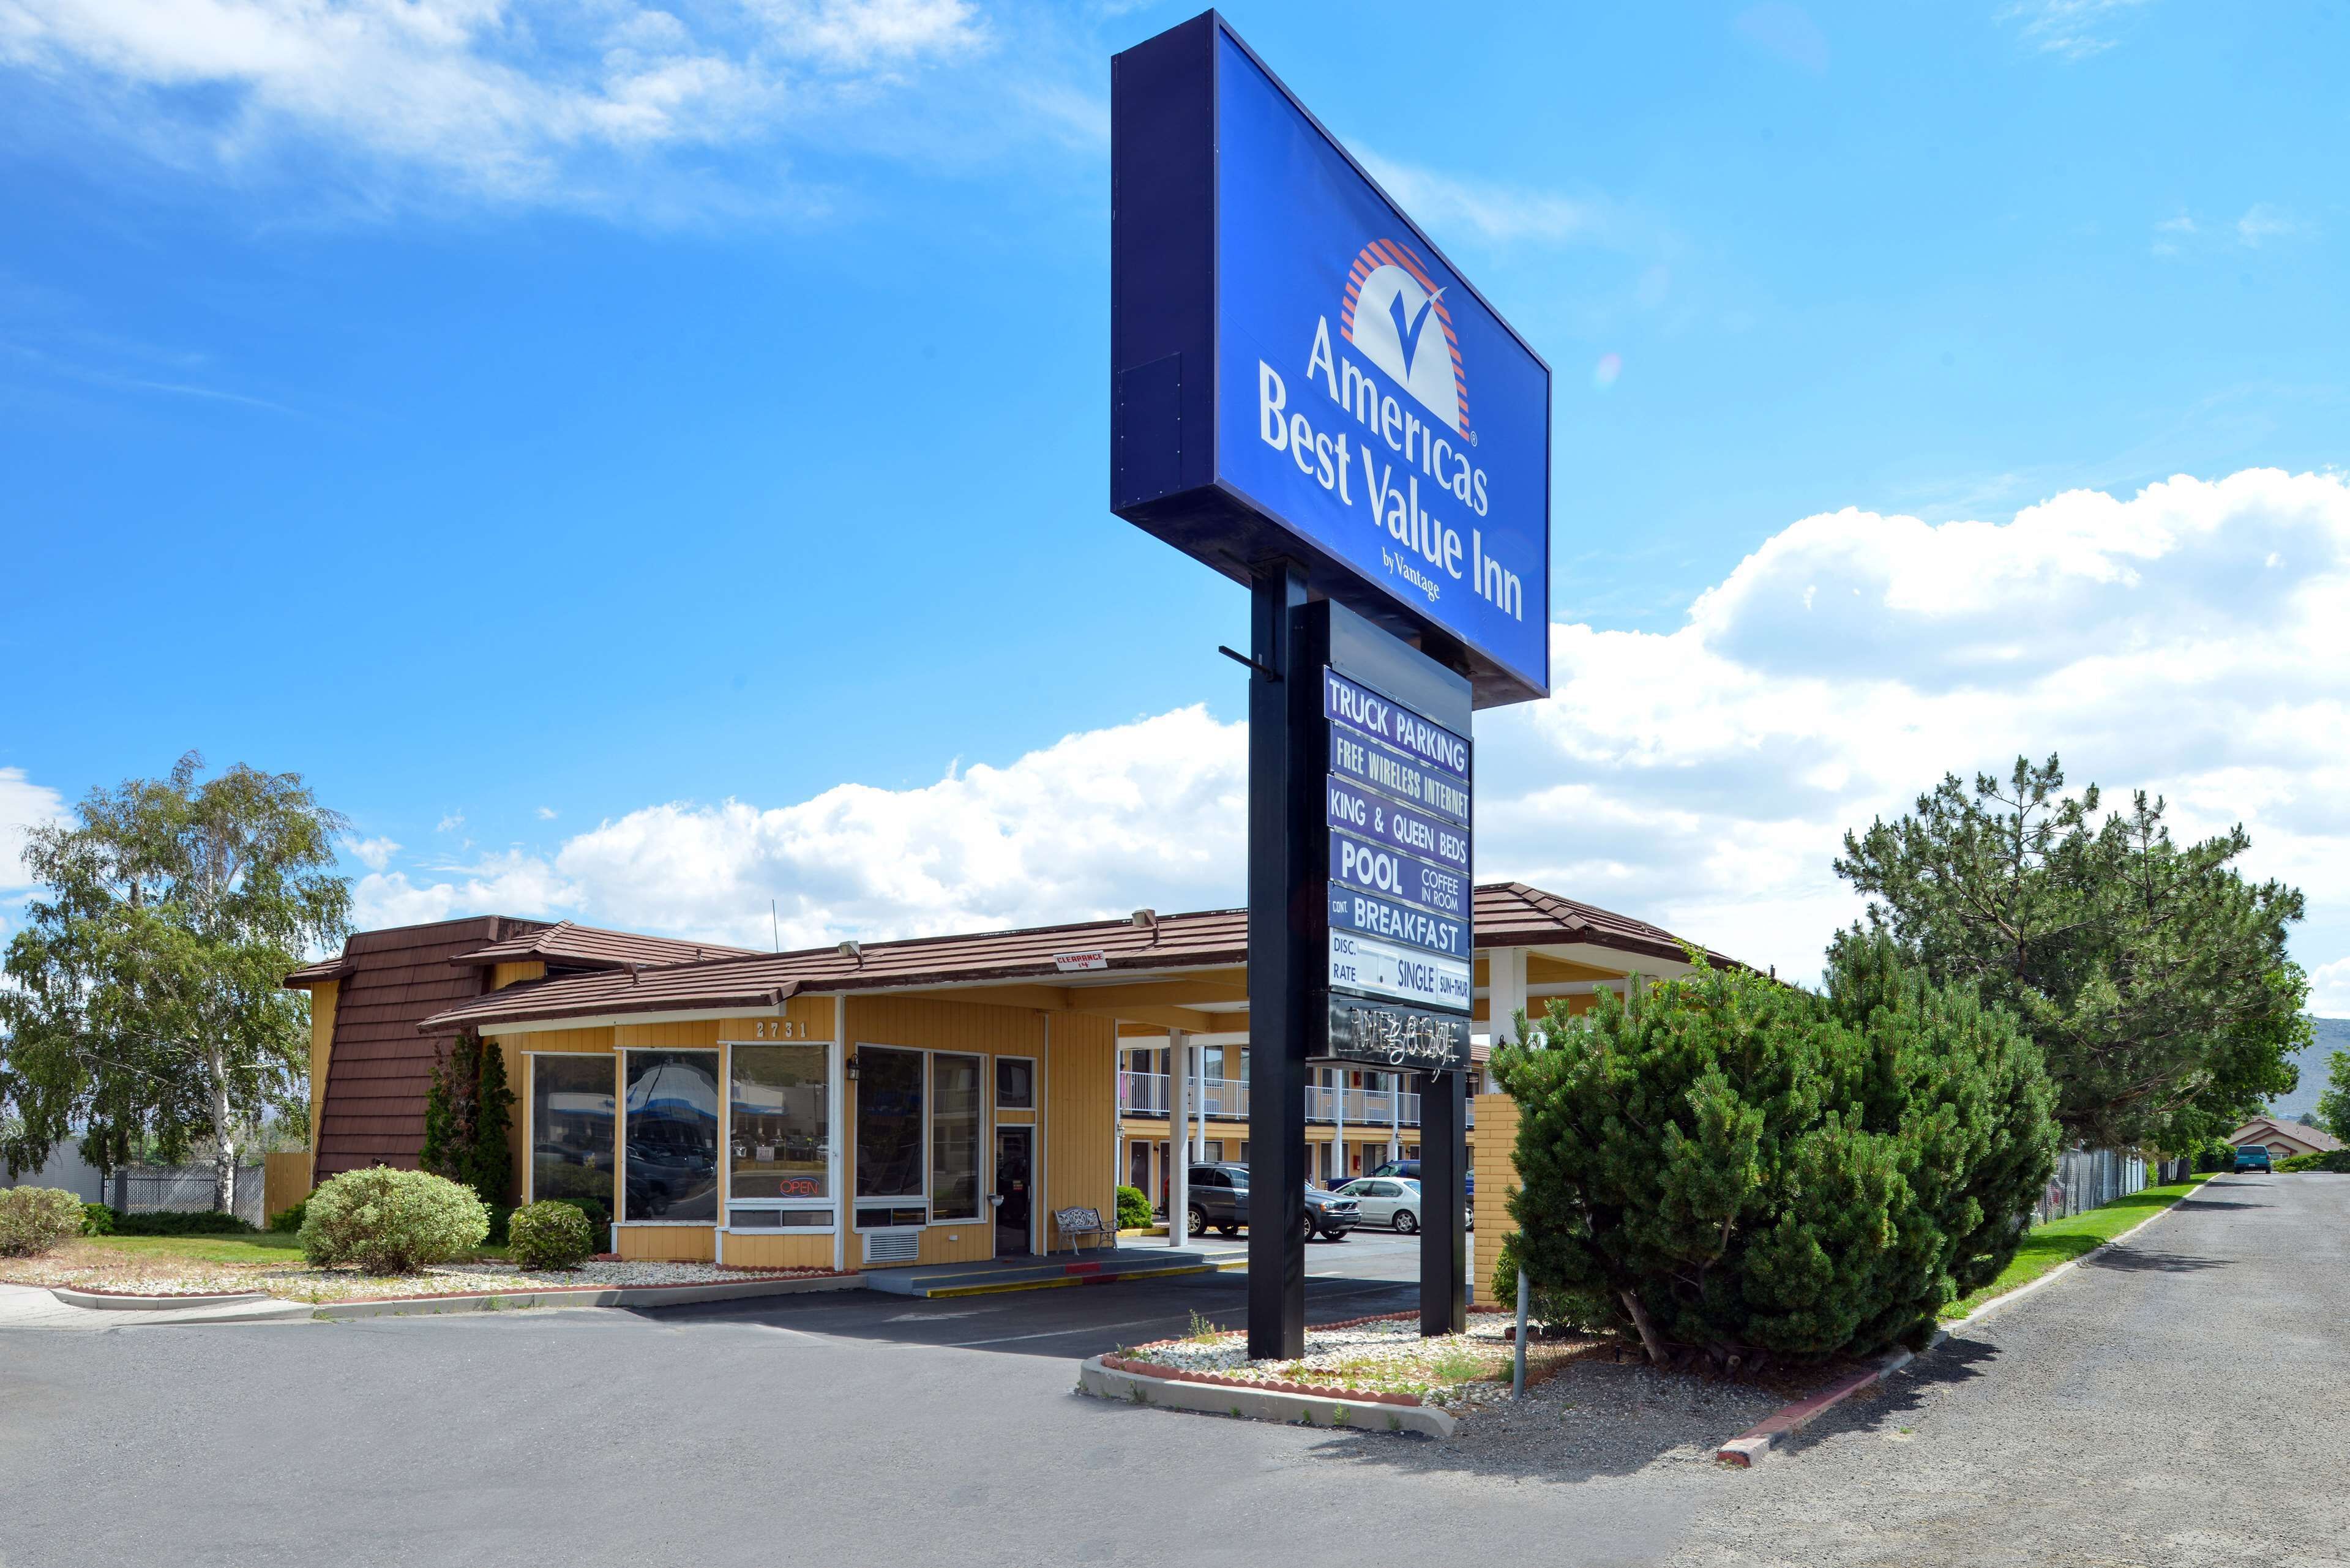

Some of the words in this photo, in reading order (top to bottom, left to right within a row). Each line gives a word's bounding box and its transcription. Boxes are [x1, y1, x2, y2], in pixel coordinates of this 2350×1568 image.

[1307, 315, 1488, 517] Americas
[1259, 358, 1352, 506] Best
[1361, 442, 1462, 579] Value
[1473, 528, 1522, 622] Inn
[1382, 545, 1394, 574] by
[1394, 552, 1440, 602] Vantage
[1329, 678, 1389, 736] TRUCK
[1397, 712, 1464, 772] PARKING
[1337, 737, 1364, 775] FREE
[1369, 751, 1420, 799] WIRELESS
[1424, 777, 1469, 819] INTERNET
[1331, 789, 1366, 826] KING
[1374, 807, 1385, 833] &
[1393, 814, 1434, 851] QUEEN
[1440, 832, 1466, 864] BEDS
[1342, 840, 1402, 895] POOL
[1422, 868, 1458, 895] COFFEE
[1422, 887, 1431, 903] IN
[1434, 890, 1458, 911] ROOM
[1334, 938, 1356, 955] DISC.
[1355, 897, 1458, 952] BREAKFAST
[1057, 954, 1103, 963] CLEARANCE
[1334, 963, 1356, 982] RATE
[1398, 959, 1434, 993] SINGLE
[1440, 976, 1468, 998] SUN-THUR
[757, 1021, 806, 1038] 2731
[780, 1181, 818, 1195] OPEN
